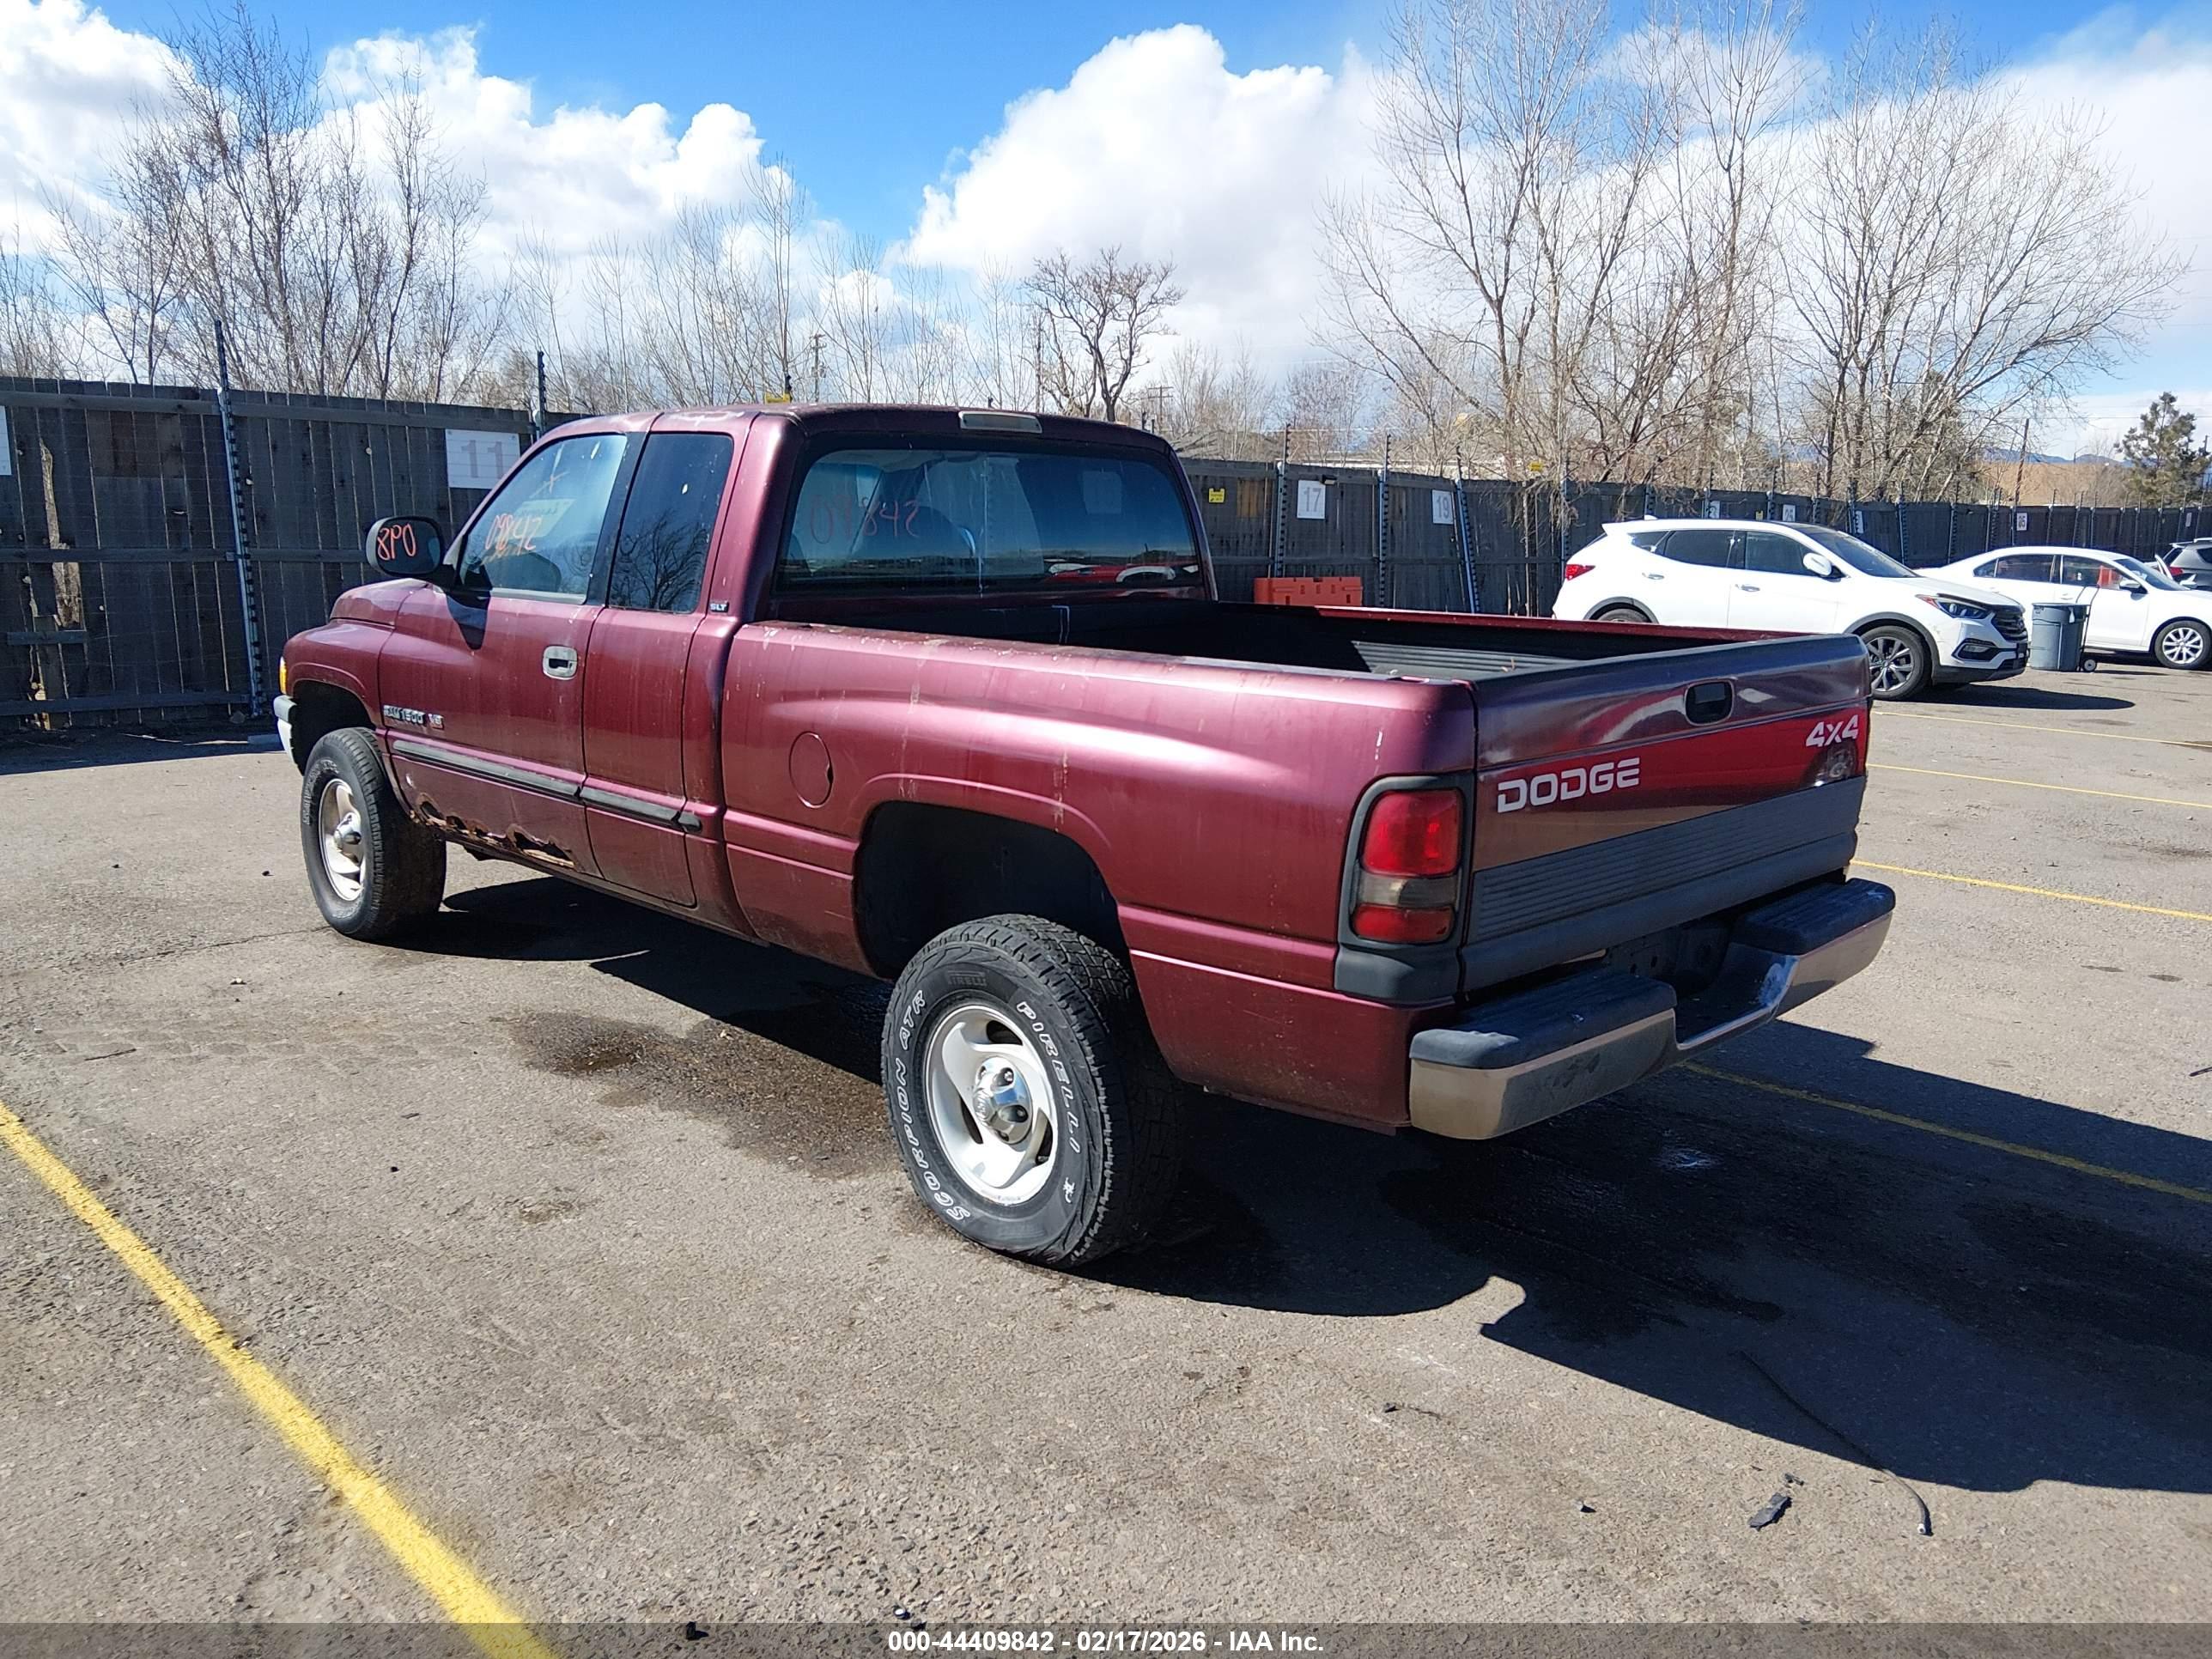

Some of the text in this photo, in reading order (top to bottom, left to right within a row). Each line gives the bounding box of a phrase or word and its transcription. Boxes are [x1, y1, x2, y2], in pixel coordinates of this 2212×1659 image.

[460, 439, 504, 479] 11
[1303, 486, 1322, 513] 17
[1437, 494, 1450, 520] 19
[1497, 757, 1640, 813] DODGE
[1016, 1001, 1081, 1154] PIRELLI
[896, 989, 971, 1221] SCORPION ATR
